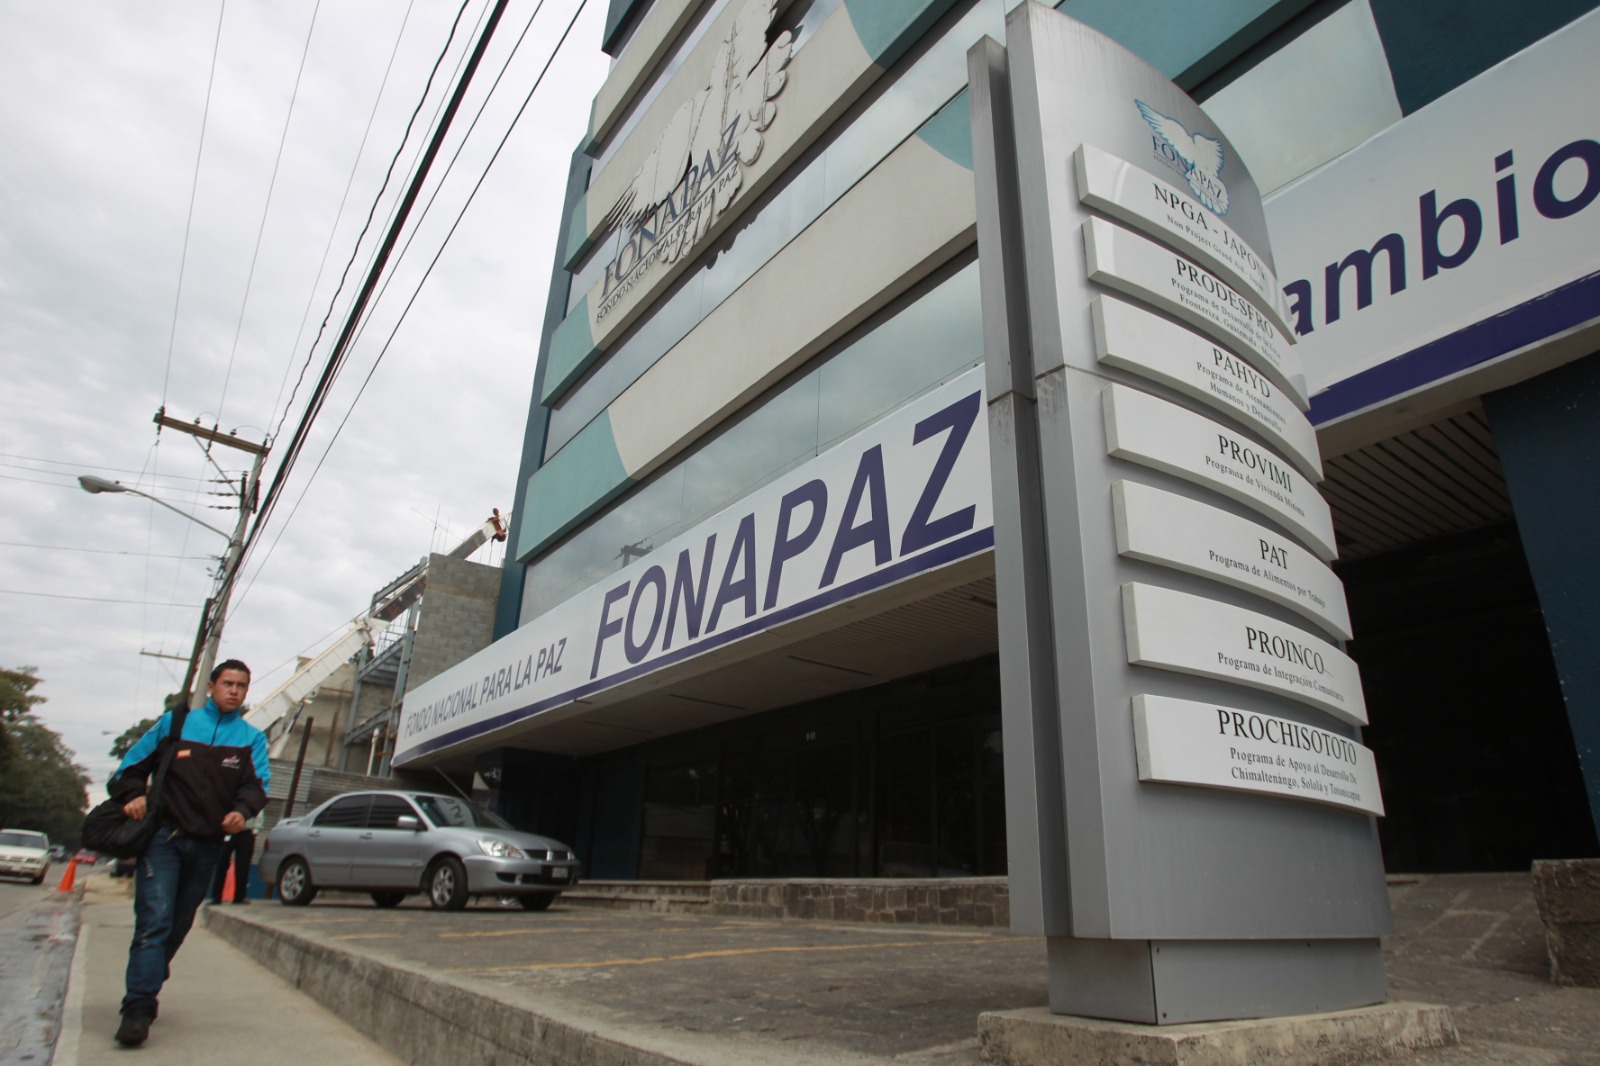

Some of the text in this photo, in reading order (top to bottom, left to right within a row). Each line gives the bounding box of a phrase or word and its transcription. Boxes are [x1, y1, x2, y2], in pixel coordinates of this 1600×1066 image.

[718, 163, 739, 193] PAZ
[1153, 182, 1208, 231] NPGA
[1223, 230, 1265, 280] JAPON
[1167, 214, 1184, 230] Non
[1185, 226, 1211, 247] Project
[1171, 278, 1209, 304] Programa
[1211, 301, 1219, 311] de
[1221, 306, 1254, 335] Desarrollo
[1175, 258, 1274, 339] PRODESFRO
[1223, 317, 1257, 347] Guatemala
[1196, 362, 1233, 388] Programa
[1235, 384, 1243, 393] de
[1212, 347, 1270, 398] PAHYD
[1210, 382, 1244, 407] Humanos
[1252, 405, 1282, 433] Desarrollo
[1205, 455, 1244, 480] Programa
[1246, 474, 1254, 485] de
[1255, 478, 1284, 503] Vivienda
[1217, 434, 1292, 493] PROVIMI
[404, 389, 982, 738] FONDO NACIONAL PARA LA PAZ FONAPAZ
[1208, 549, 1249, 572] Programa
[1251, 564, 1261, 576] de
[1263, 569, 1297, 592] Alimentos
[1297, 586, 1307, 597] por
[1259, 538, 1288, 570] PAT
[1217, 652, 1260, 673] Programa
[1262, 663, 1272, 675] de
[1245, 626, 1325, 674] PROINCO
[1216, 709, 1357, 766] PROCHISOTOTO
[1230, 747, 1273, 765] Programa
[1275, 754, 1285, 767] de
[1288, 758, 1312, 774] Apoyo
[1313, 765, 1320, 774] al
[1320, 764, 1349, 780] Desarrollo
[1324, 785, 1328, 796] y
